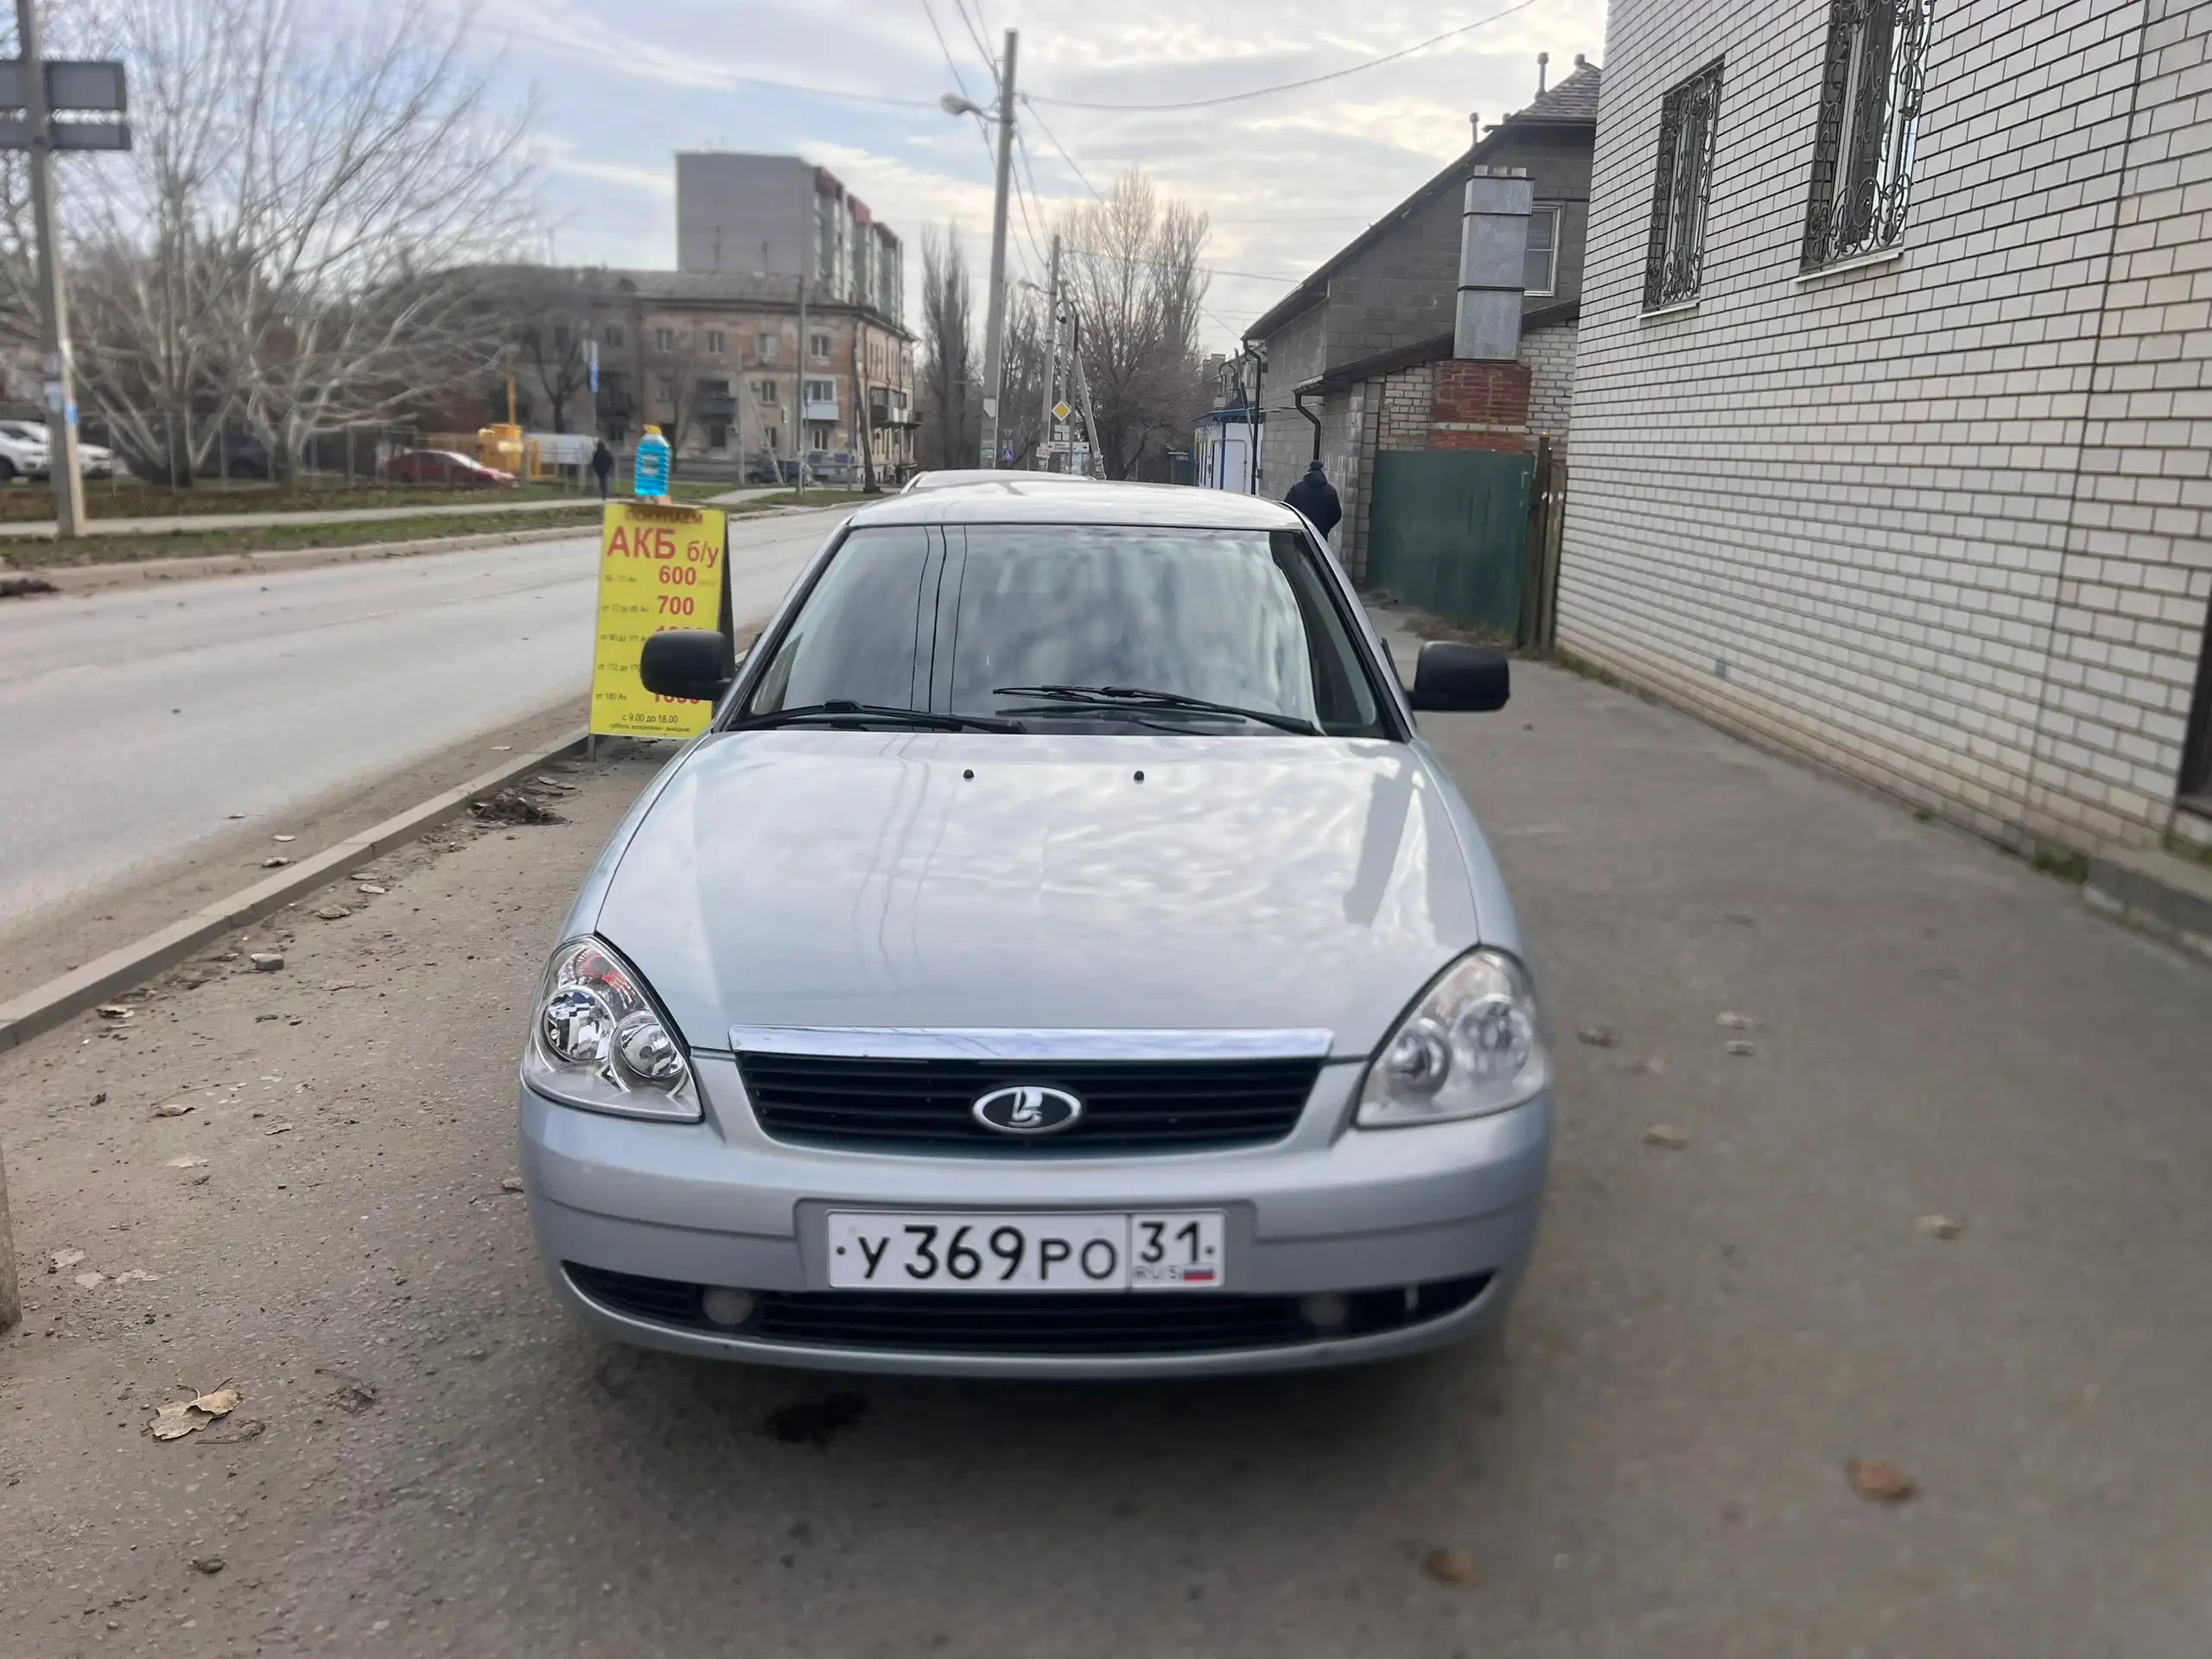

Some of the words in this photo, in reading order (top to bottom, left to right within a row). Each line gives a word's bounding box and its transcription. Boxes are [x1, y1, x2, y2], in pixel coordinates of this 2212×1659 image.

[607, 525, 677, 560] АКБ
[687, 540, 720, 569] б/у
[659, 565, 696, 586] 600
[658, 595, 695, 615] 700
[628, 712, 645, 722] 9.00
[658, 715, 678, 724] 18.00
[1140, 1220, 1200, 1264] 31
